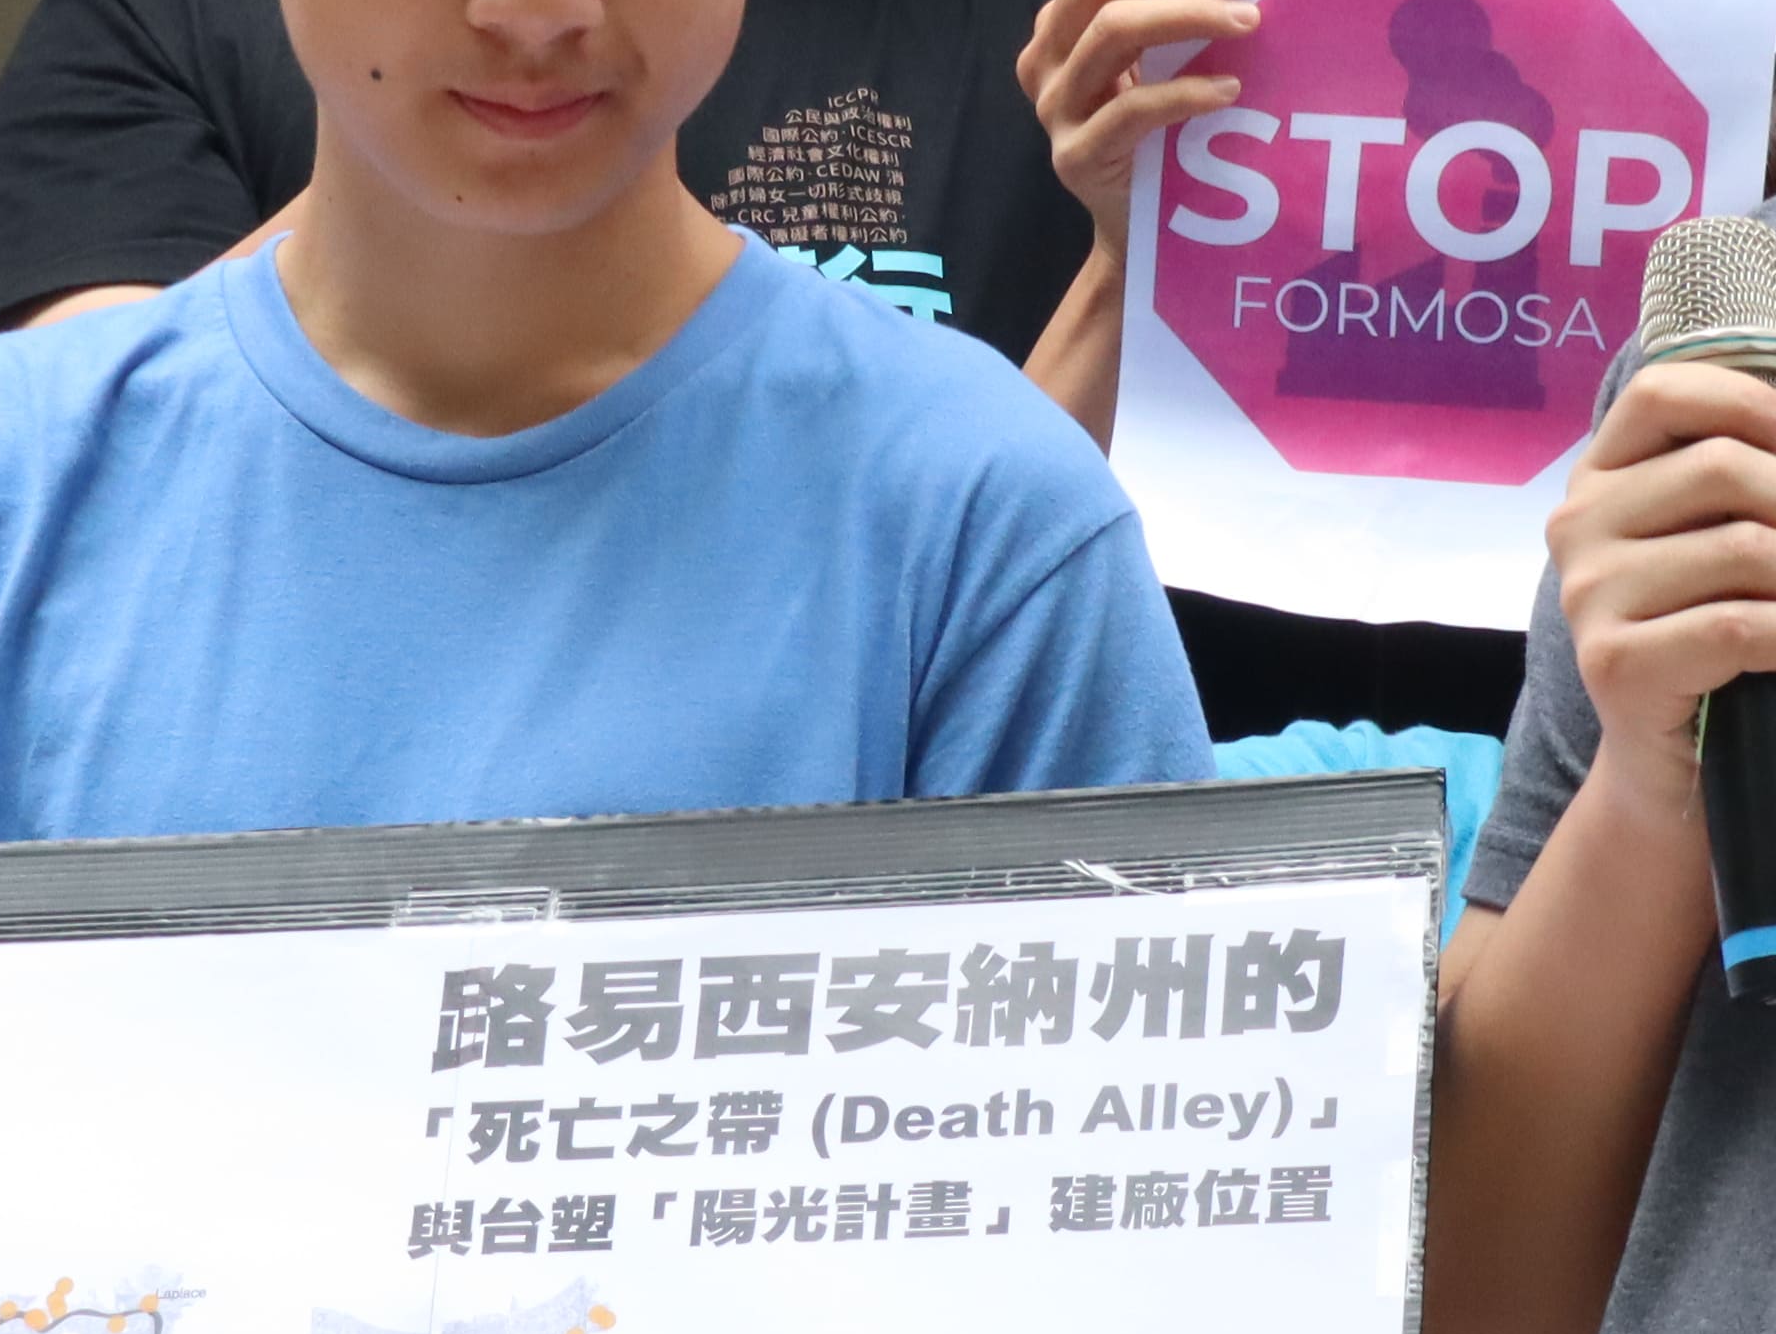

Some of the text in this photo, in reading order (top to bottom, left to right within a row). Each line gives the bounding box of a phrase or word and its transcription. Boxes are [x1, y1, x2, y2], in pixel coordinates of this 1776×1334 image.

[827, 86, 880, 109] ICCPR
[1167, 108, 1693, 267] STOP
[760, 223, 908, 245] 障礙者權利公約
[1233, 277, 1606, 352] FORMOSA
[430, 928, 1346, 1074] 路易西安納州的
